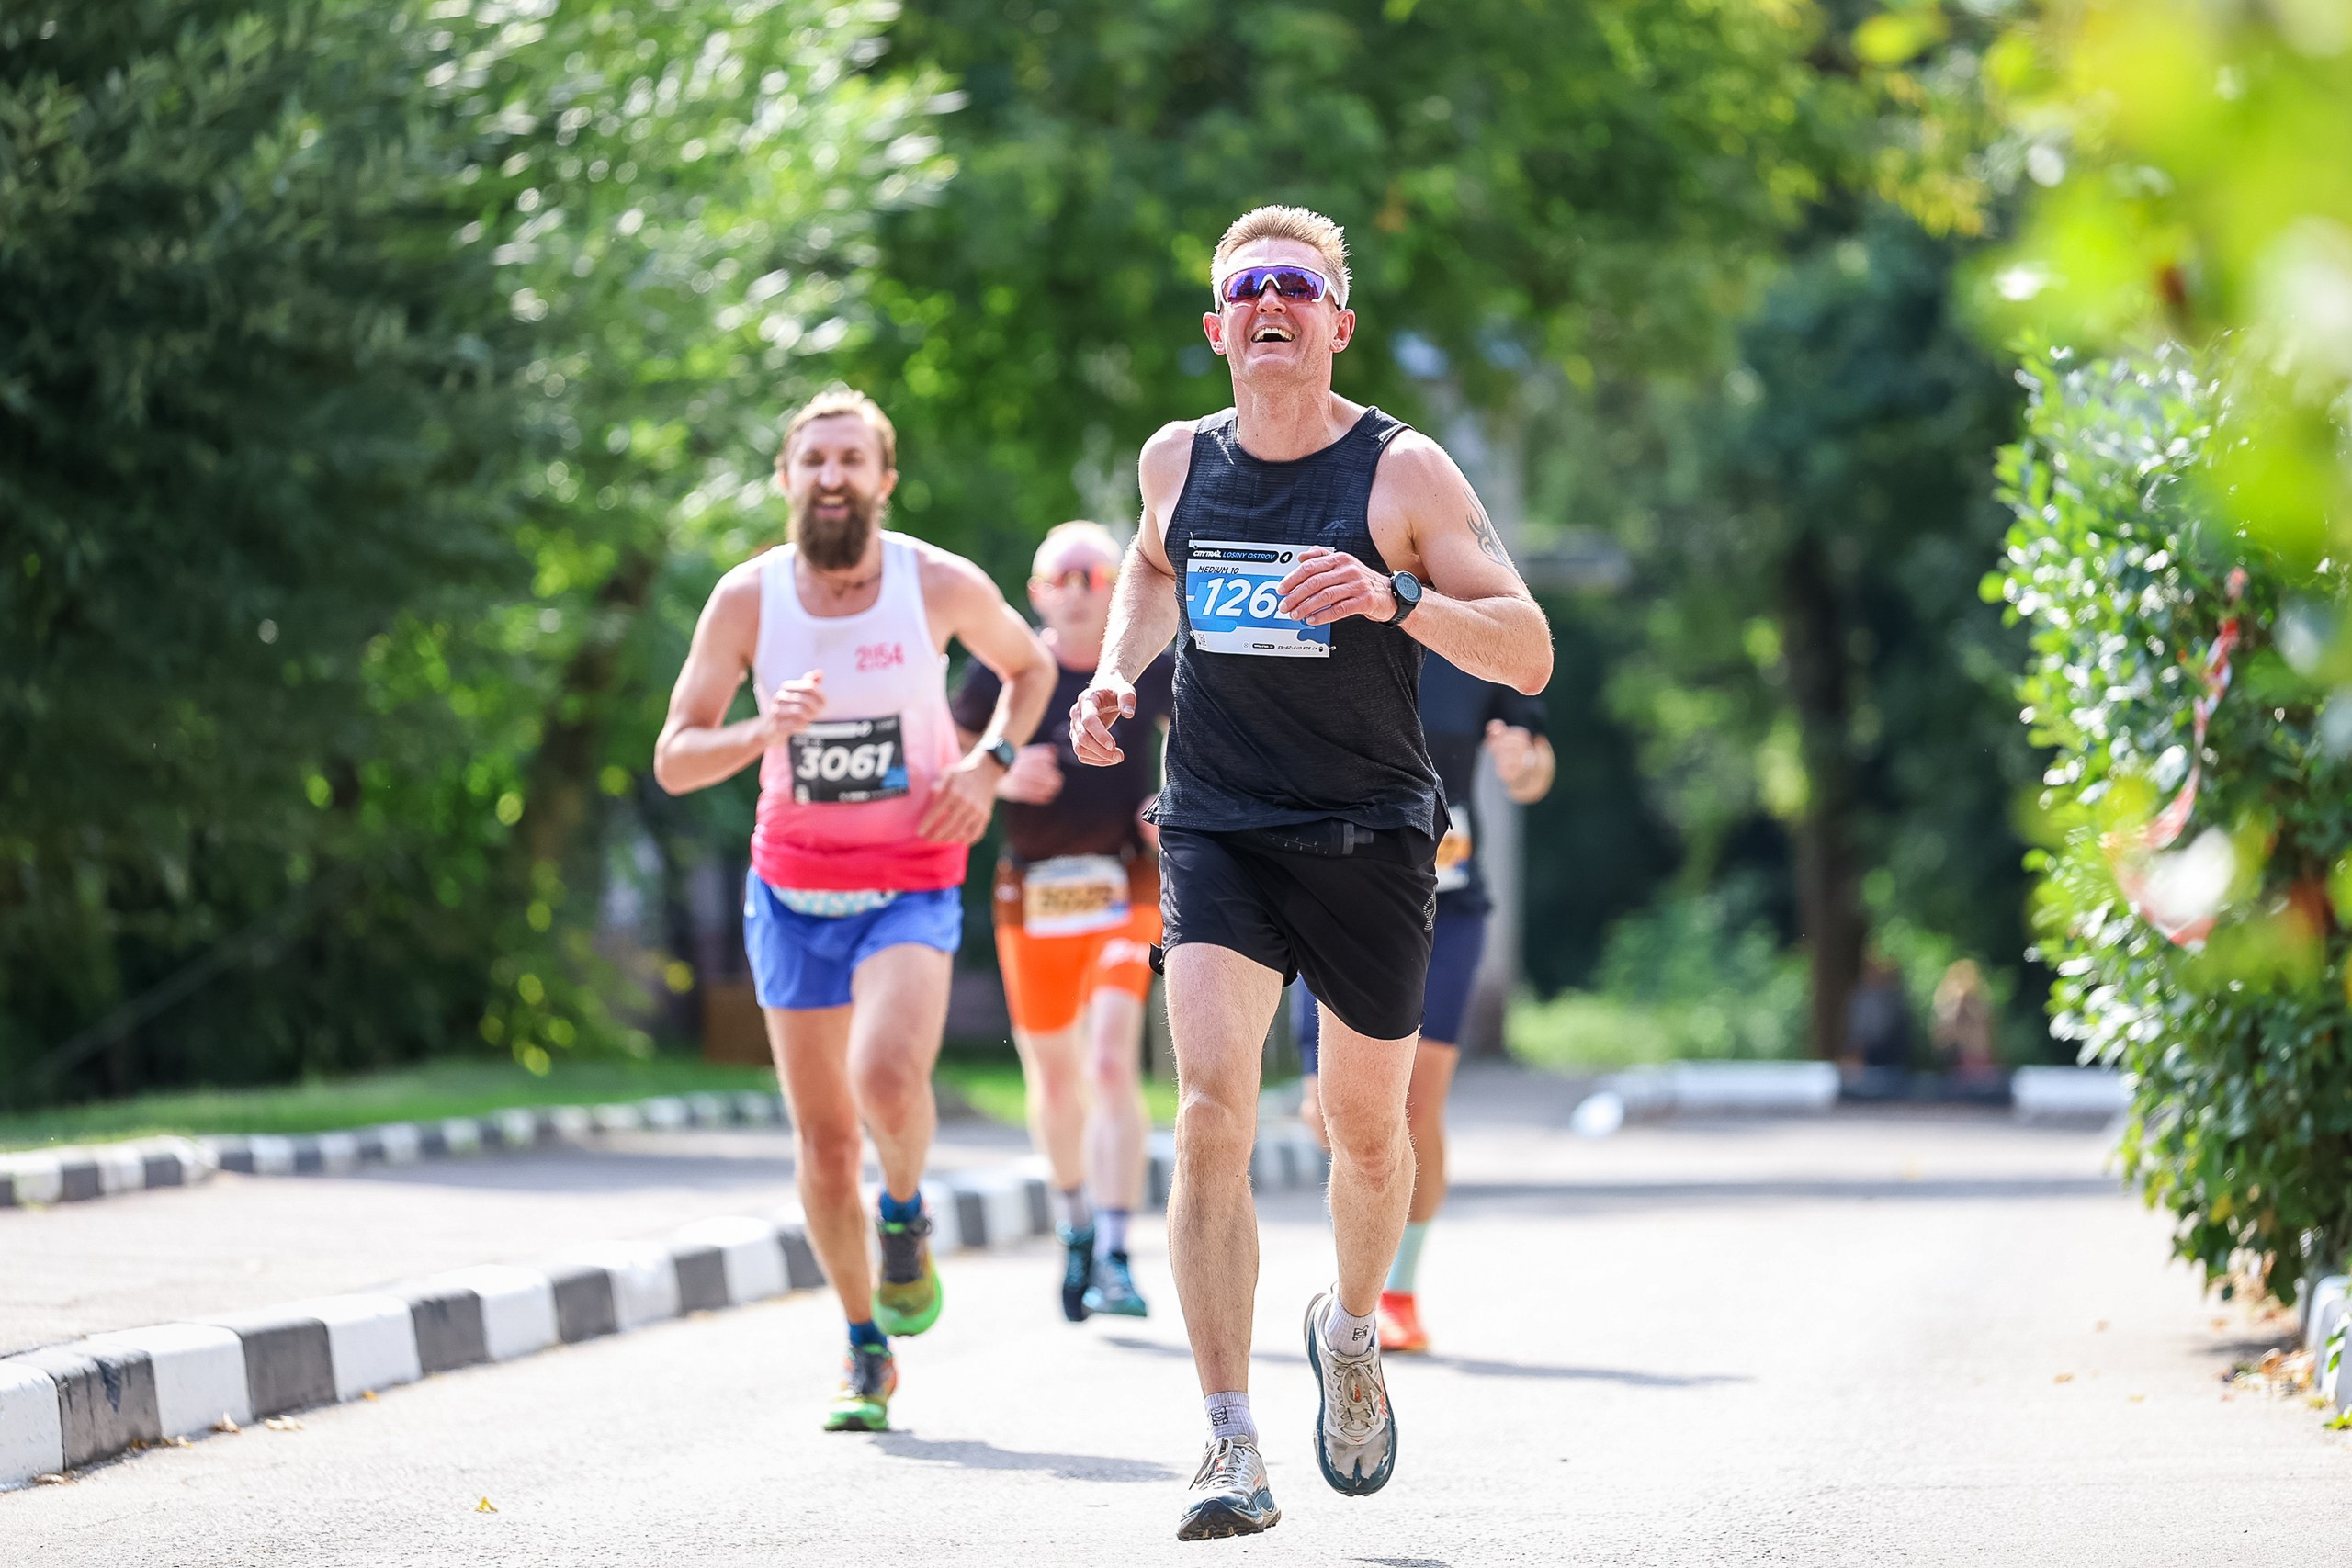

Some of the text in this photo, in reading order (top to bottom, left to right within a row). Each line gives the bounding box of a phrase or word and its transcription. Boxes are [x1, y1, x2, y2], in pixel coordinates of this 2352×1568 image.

[1247, 552, 1276, 560] OSTROV
[1282, 553, 1290, 561] 4
[1197, 566, 1240, 575] MEDIUM 10
[1202, 577, 1292, 620] 126
[796, 740, 895, 782] 3061
